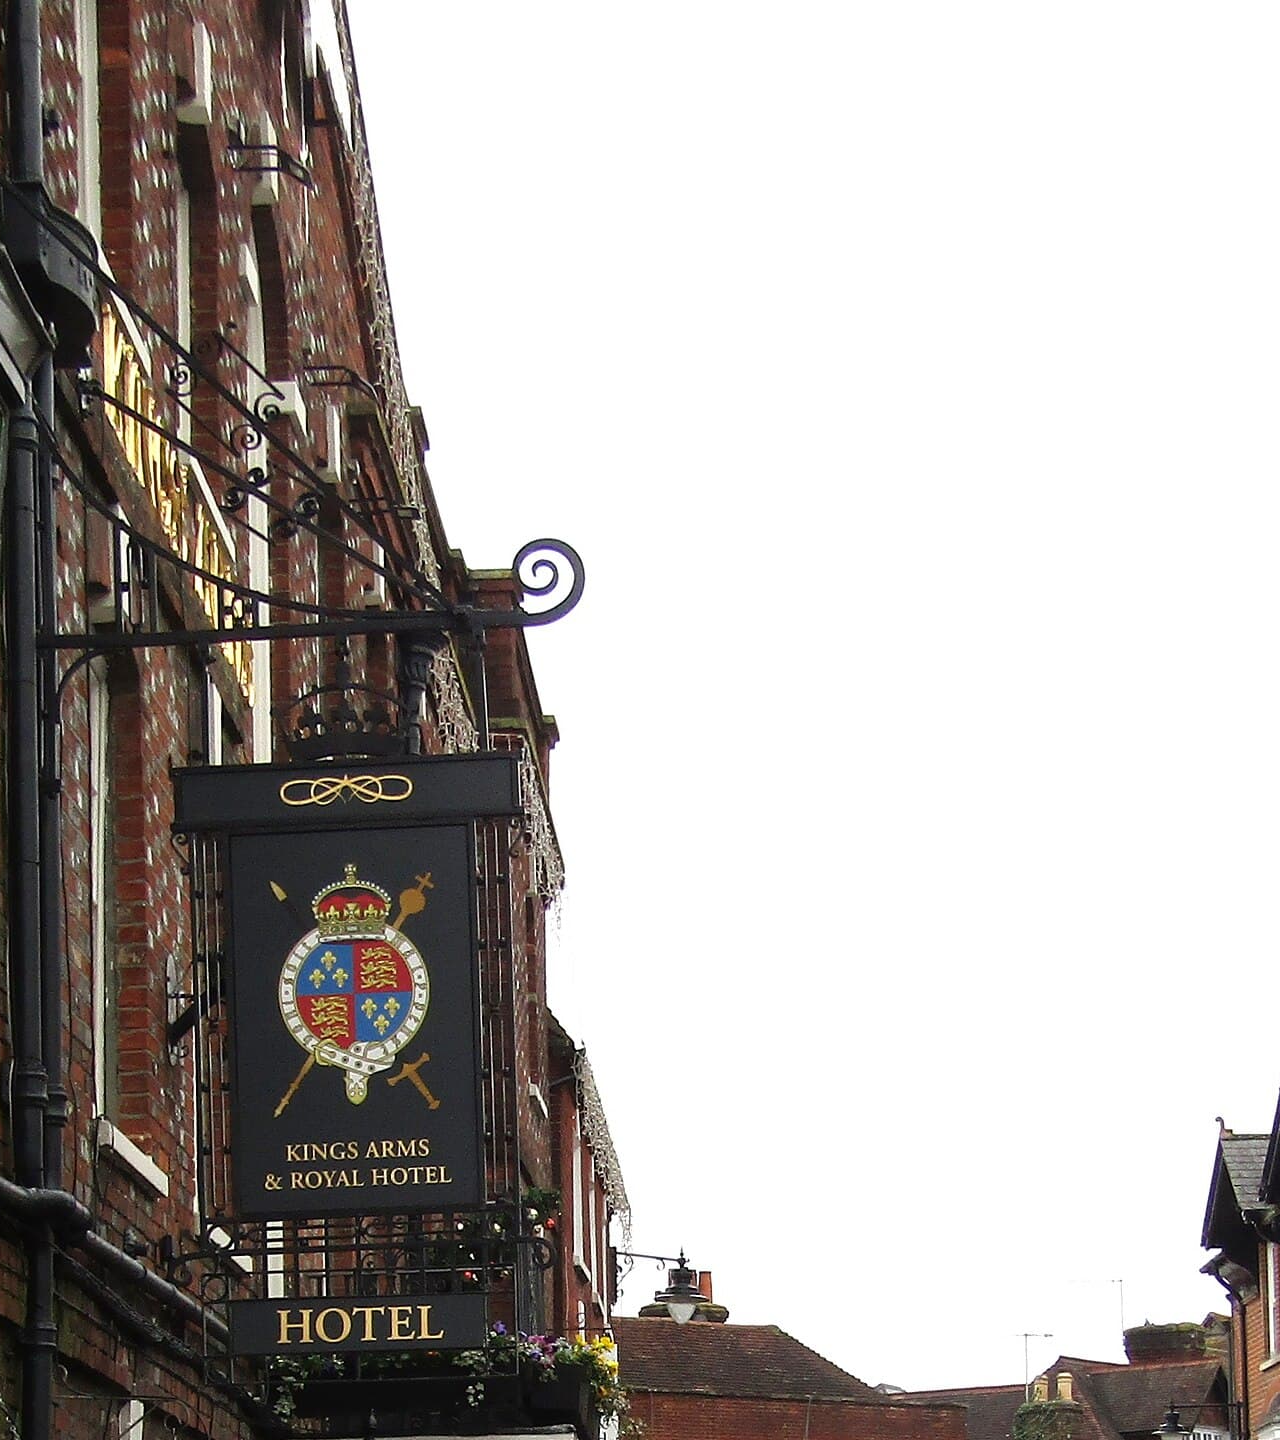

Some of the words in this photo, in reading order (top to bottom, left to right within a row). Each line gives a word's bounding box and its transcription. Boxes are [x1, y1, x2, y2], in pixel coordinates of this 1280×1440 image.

[286, 1142, 359, 1162] KINGS
[365, 1139, 430, 1159] ARMS
[264, 1173, 283, 1190] &
[290, 1169, 364, 1189] ROYAL
[371, 1166, 452, 1186] HOTEL
[276, 1305, 444, 1344] HOTEL
